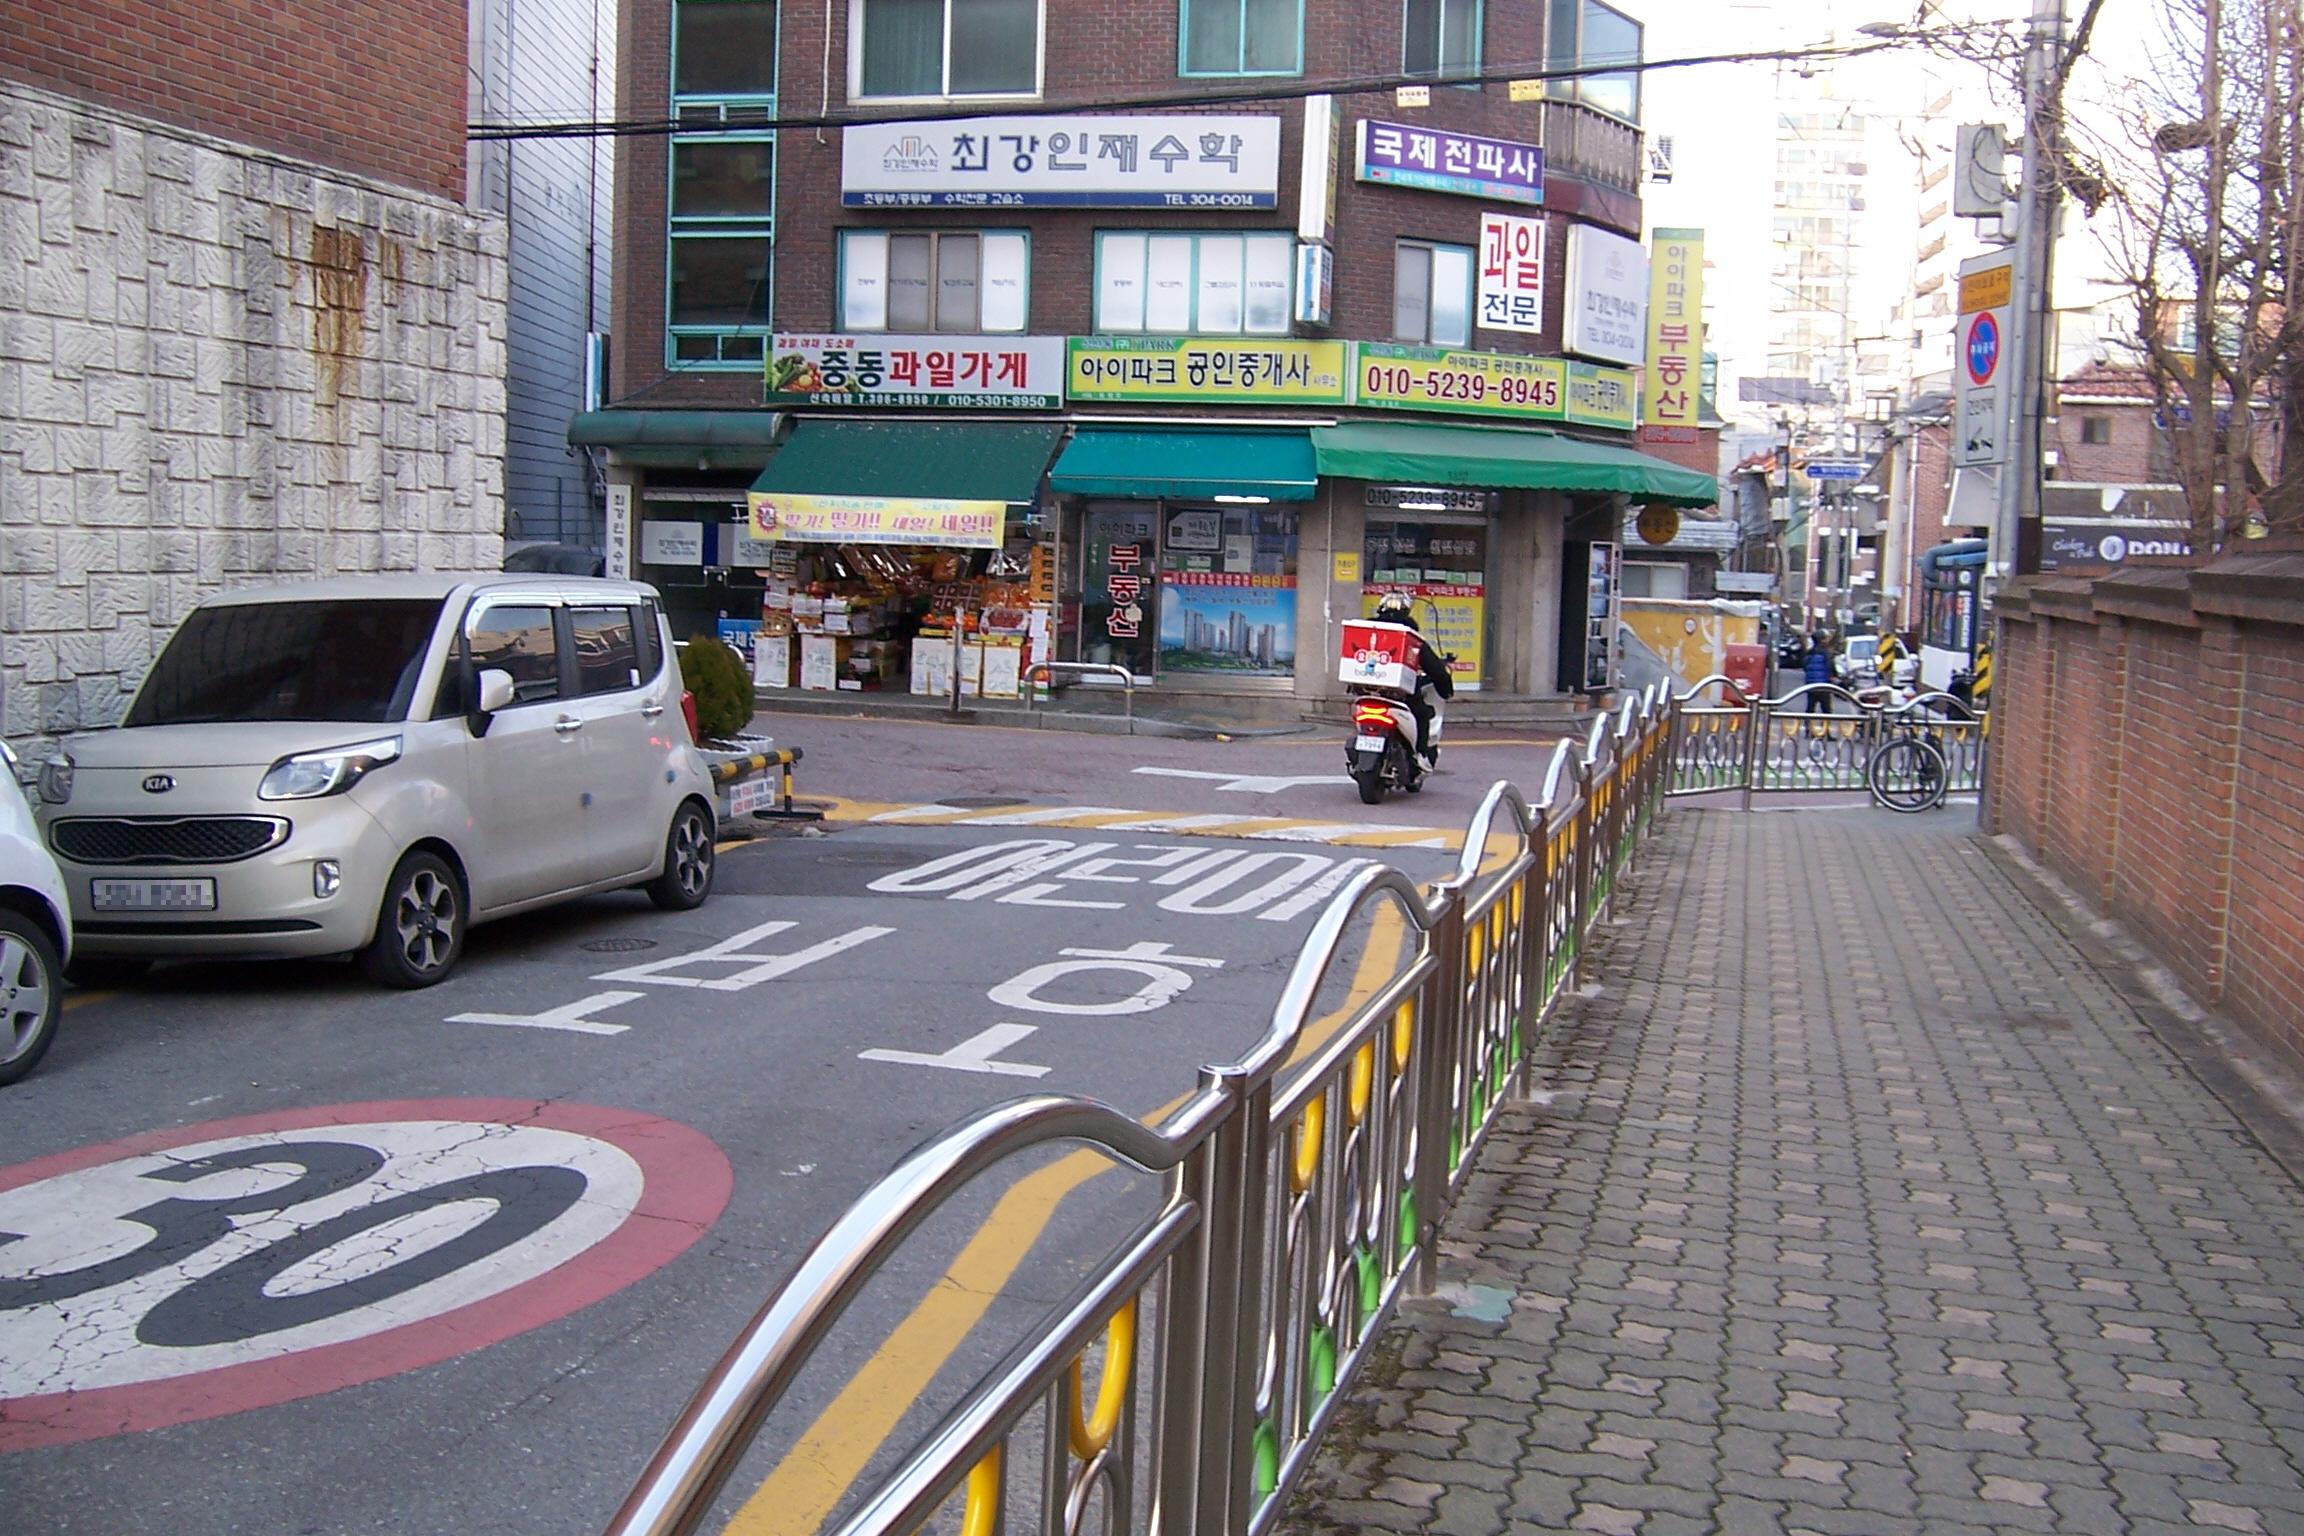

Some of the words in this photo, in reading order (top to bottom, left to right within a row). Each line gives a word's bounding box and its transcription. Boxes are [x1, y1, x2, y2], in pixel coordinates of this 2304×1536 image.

[952, 131, 1243, 174] 최강인재수학
[1373, 128, 1537, 183] 국제전파사
[1164, 193, 1187, 205] TEL
[1189, 193, 1254, 205] 304-0014
[1484, 221, 1539, 290] 과일
[1665, 245, 1689, 318] 아이파크
[1483, 293, 1538, 327] 전문
[820, 351, 886, 388] 중동
[888, 351, 1028, 389] 과일가게
[1081, 357, 1176, 384] 아이파크
[1187, 351, 1310, 387] 공인중개사
[1366, 366, 1557, 406] 010-5239-8945
[1655, 323, 1689, 420] 부동산
[948, 395, 1046, 407] 010-5301-8950
[145, 777, 170, 790] KIA
[0, 1141, 588, 1348] 30
